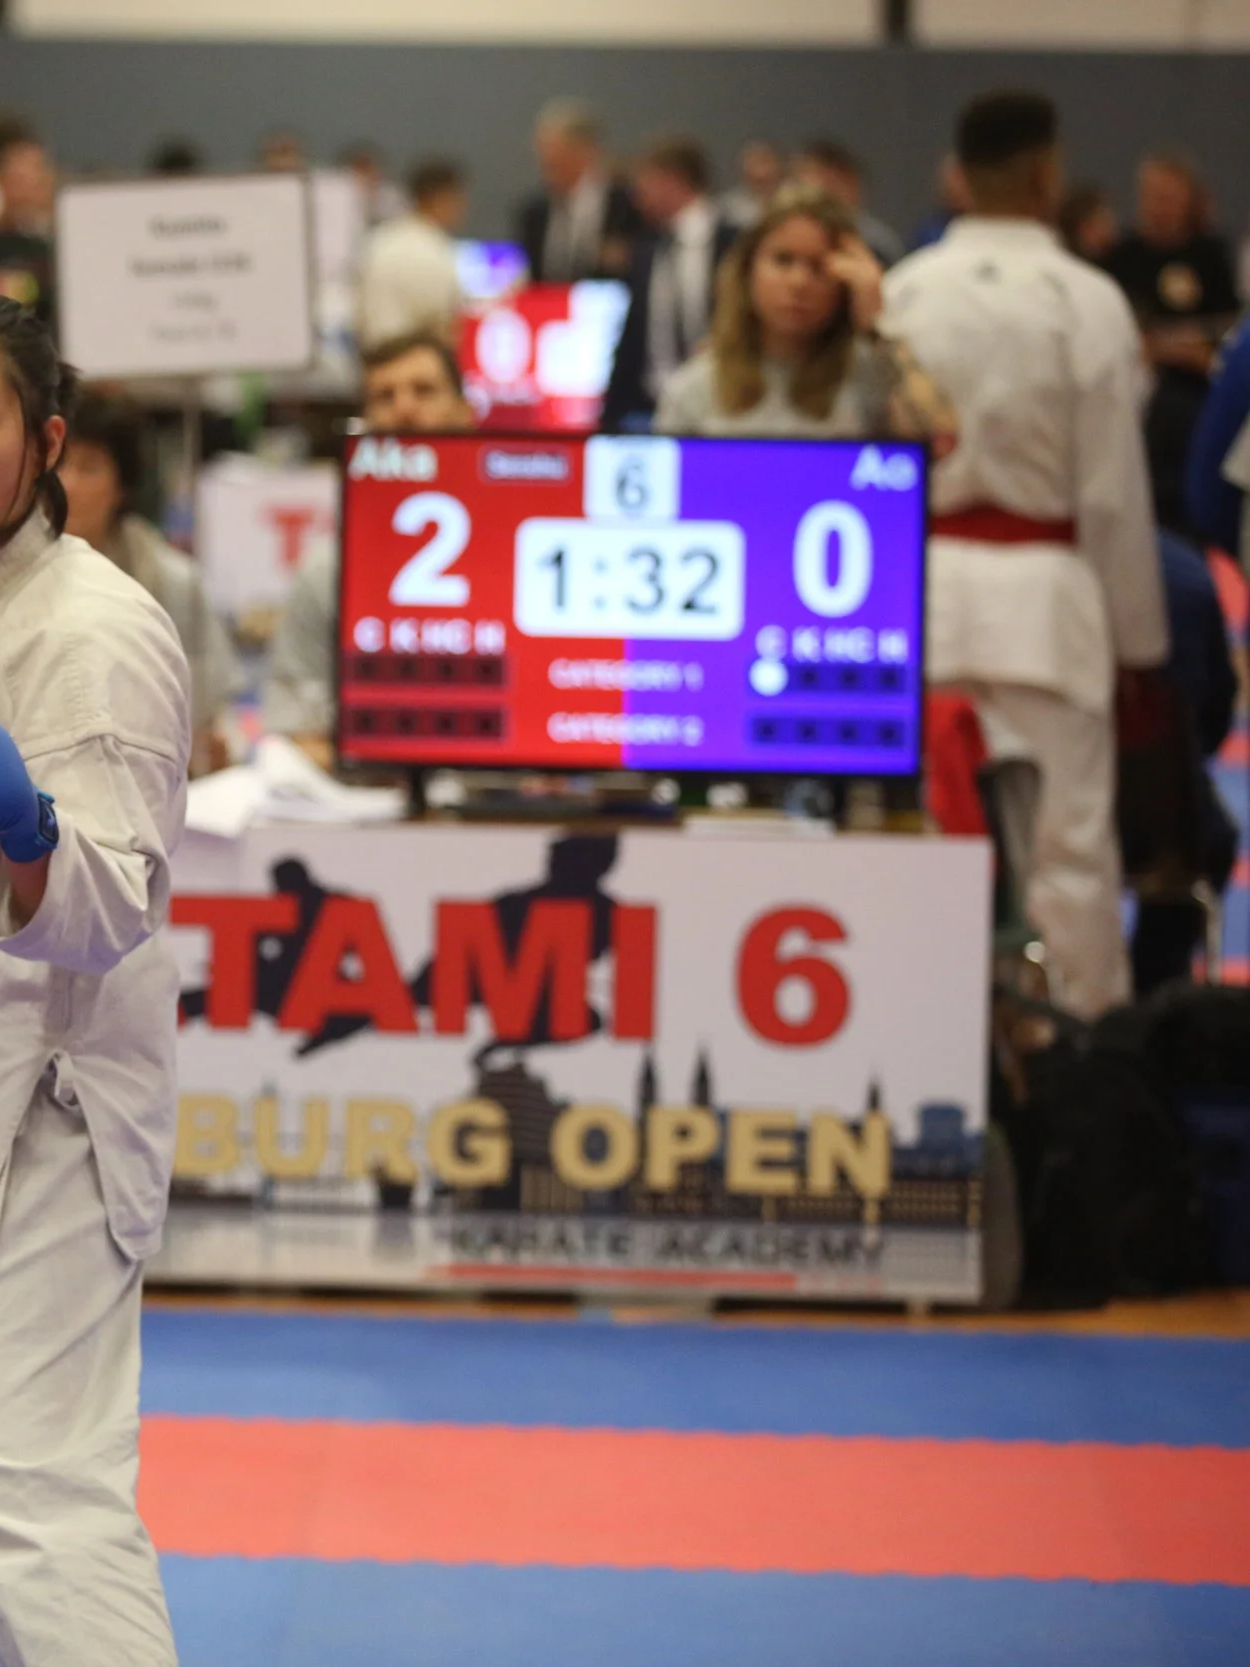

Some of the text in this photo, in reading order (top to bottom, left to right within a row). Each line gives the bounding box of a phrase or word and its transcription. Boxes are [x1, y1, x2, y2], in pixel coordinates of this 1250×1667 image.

[350, 437, 437, 481] Aka
[616, 458, 649, 513] 6
[850, 444, 918, 491] Ao
[389, 490, 472, 607] 2
[537, 545, 722, 615] 1:32
[793, 499, 874, 619] 0
[171, 893, 852, 1047] TAMI 6
[550, 1103, 892, 1197] OPEN
